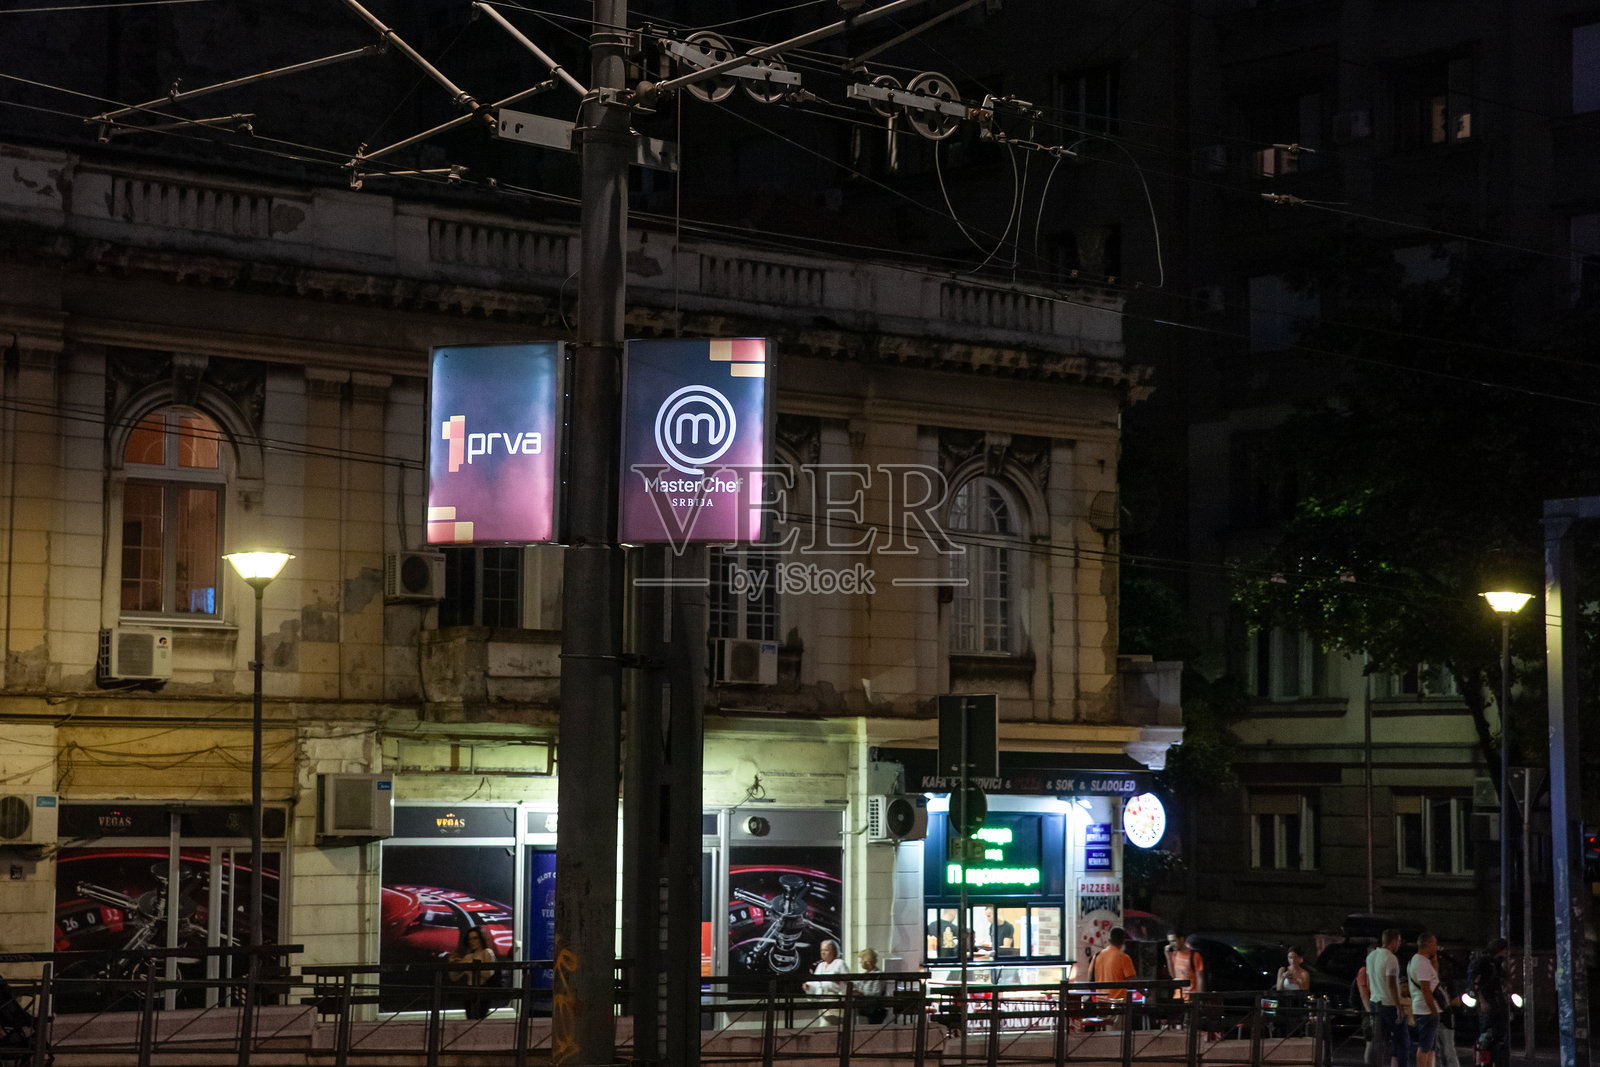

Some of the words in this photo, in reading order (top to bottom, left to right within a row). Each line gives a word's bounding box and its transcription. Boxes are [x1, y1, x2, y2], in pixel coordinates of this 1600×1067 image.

[467, 432, 541, 464] prva
[645, 477, 743, 493] MasterChef
[672, 498, 713, 507] SRBIJA
[1056, 779, 1074, 791] SOK
[1091, 780, 1136, 791] SLADOLED
[98, 816, 132, 827] VEGAS
[436, 818, 466, 828] VEGAS
[1081, 884, 1120, 893] PIZZERIA
